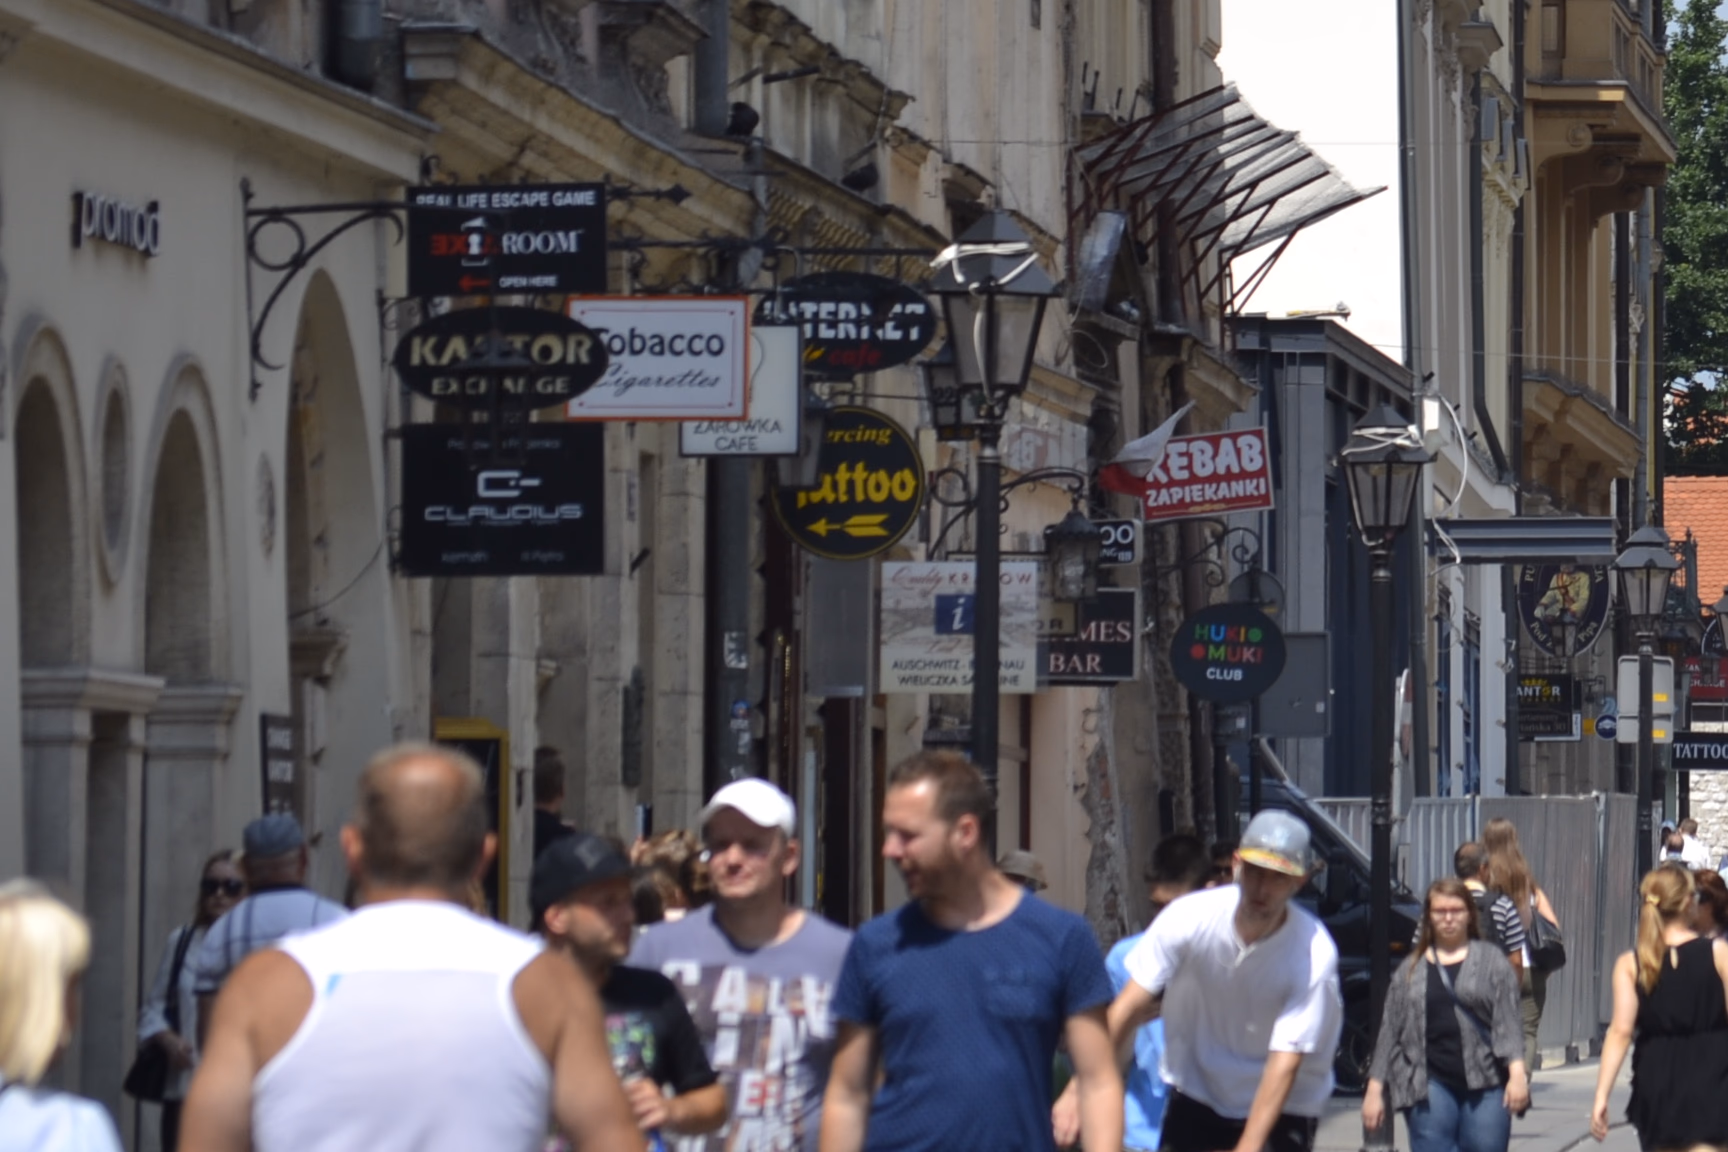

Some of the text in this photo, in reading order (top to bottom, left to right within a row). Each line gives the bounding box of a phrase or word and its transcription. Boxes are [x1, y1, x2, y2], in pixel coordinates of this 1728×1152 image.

[457, 192, 488, 208] LIFE
[491, 191, 549, 208] ESCAPE
[552, 189, 597, 207] GAME
[71, 191, 161, 256] promod
[501, 230, 578, 255] ROOM
[410, 333, 594, 367] KATOR
[714, 436, 759, 452] CAFE
[1145, 477, 1267, 508] ZAPIEKANKI
[424, 503, 584, 522] CLAUDIUS
[949, 571, 1033, 586] KROW
[891, 658, 961, 671] AUSCHWITZ
[1049, 652, 1102, 674] BAR
[898, 675, 957, 687] WIELICZKA
[1206, 666, 1244, 681] CLUB
[1516, 685, 1561, 697] ANTOR
